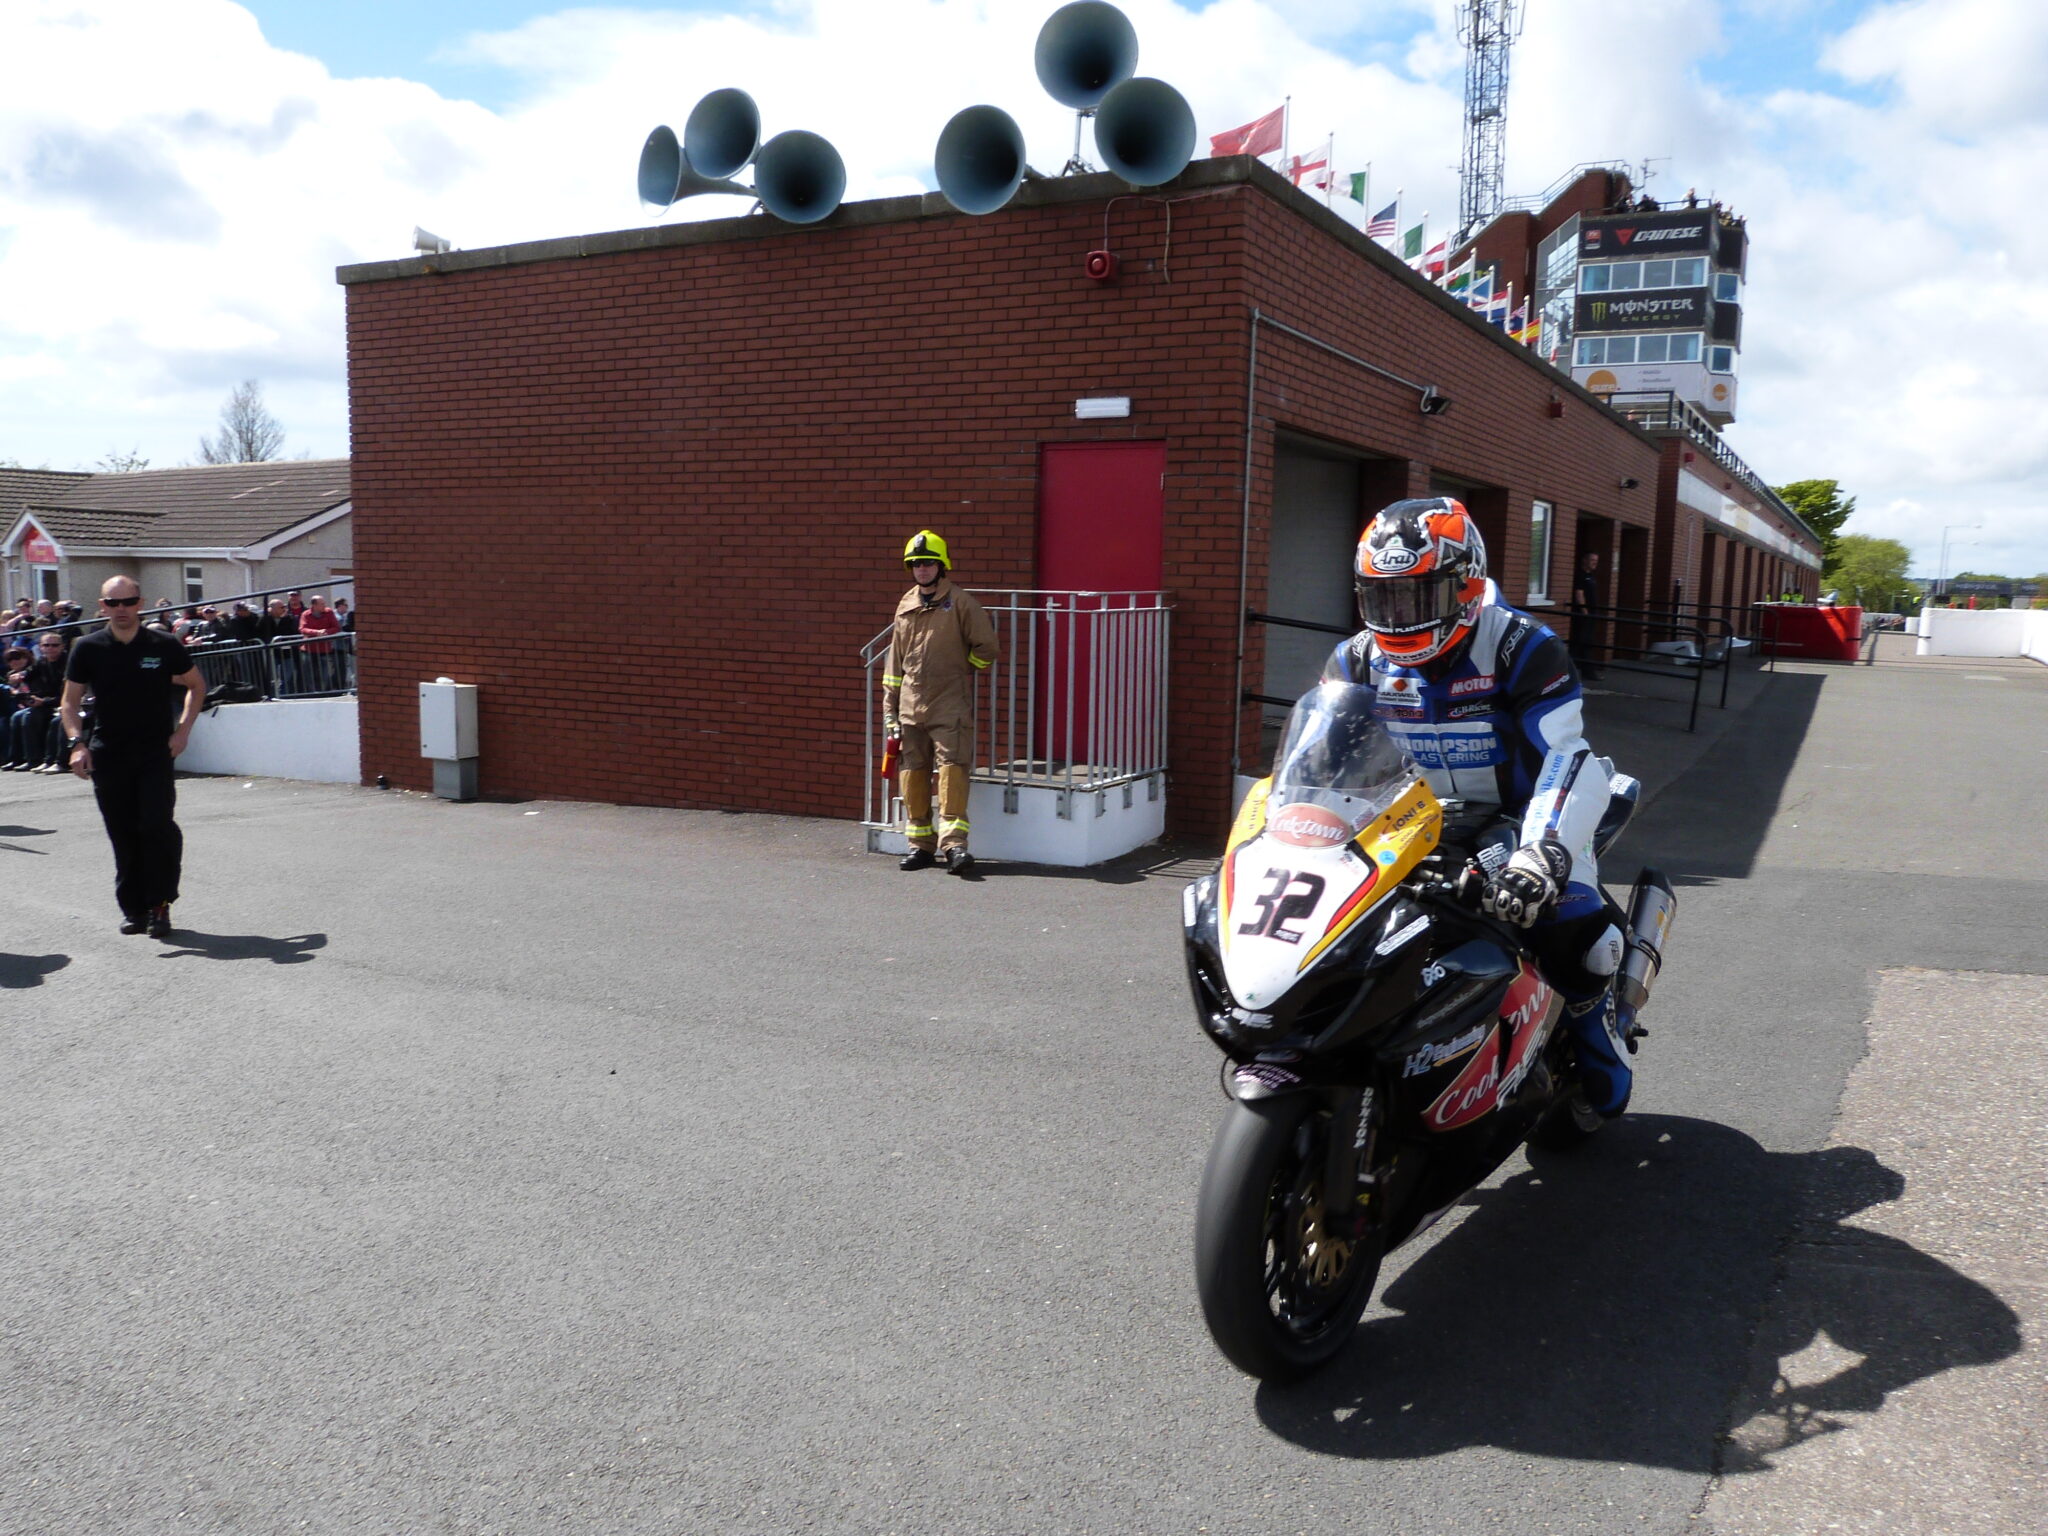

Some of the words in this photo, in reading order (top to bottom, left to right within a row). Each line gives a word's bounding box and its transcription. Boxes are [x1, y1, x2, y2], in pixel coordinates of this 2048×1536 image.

[1609, 298, 1694, 316] MONSTER
[1621, 314, 1680, 322] ENERGY
[1373, 551, 1413, 566] Arai
[1237, 867, 1326, 945] 32
